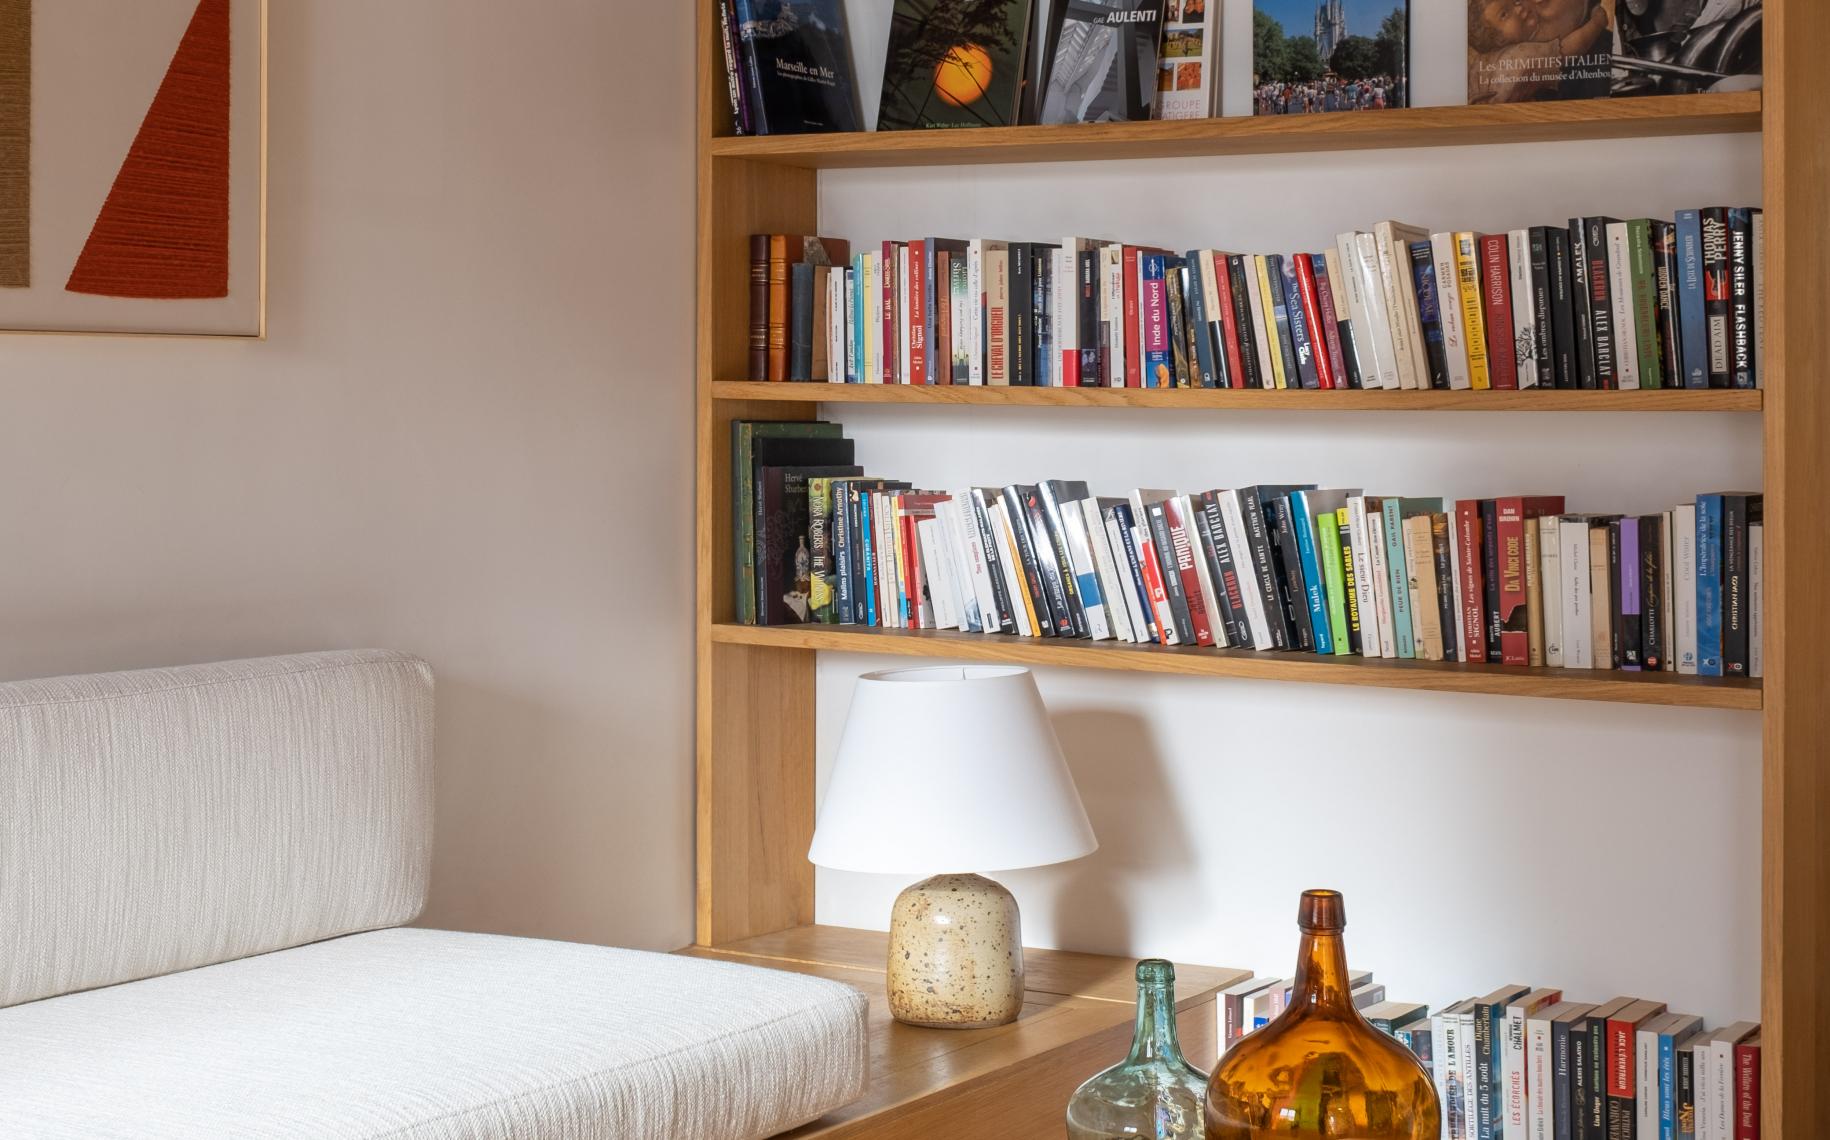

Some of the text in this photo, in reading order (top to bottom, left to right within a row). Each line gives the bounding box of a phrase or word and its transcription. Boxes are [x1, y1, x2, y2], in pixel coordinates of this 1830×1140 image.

[1093, 10, 1158, 24] GAE AULENTI
[776, 57, 808, 74] Marseille
[809, 67, 818, 76] en
[819, 66, 835, 79] Mer
[1479, 56, 1562, 72] Les PRIMITIFS
[1479, 71, 1568, 84] La collection du musée
[1702, 217, 1716, 266] THOMAS
[1715, 220, 1727, 260] PERRY
[1439, 261, 1447, 289] CARMEN
[1444, 261, 1453, 288] POSADAS
[1487, 240, 1504, 305] COLIN HARRISON
[1574, 242, 1584, 284] AMALEK
[1289, 292, 1301, 311] Sea
[1732, 230, 1747, 369] JENNY SILER FLASHBACK
[990, 307, 1004, 343] D'ORGUEIL
[1150, 282, 1161, 346] Inde du Nord
[1292, 310, 1304, 342] Sisters
[1537, 287, 1549, 360] Les ombres disparues
[915, 325, 924, 349] Signol
[1595, 310, 1611, 376] ALEX BARCLAY
[1713, 318, 1723, 369] DEAD AIM
[991, 345, 1004, 371] CHEVAL
[812, 496, 825, 516] NORA
[1247, 496, 1257, 511] PEARL
[1250, 511, 1262, 538] MATTHEW
[1277, 504, 1289, 534] John Wray
[1699, 515, 1707, 523] la
[1699, 523, 1707, 532] de
[811, 519, 825, 549] ROBERTS
[835, 487, 848, 601] Malins plaisirs Christine Arnothy
[1205, 502, 1230, 564] ALEX BARCLAY
[1463, 520, 1472, 566] Sainte-Colombe
[1170, 525, 1194, 570] PANIQUE
[1257, 545, 1267, 564] DANTE
[1343, 545, 1353, 571] SABLES
[1358, 552, 1365, 563] Le
[1699, 533, 1708, 576] L'Impératrice
[813, 556, 825, 568] THE
[1360, 564, 1368, 582] sieur
[1504, 536, 1521, 592] DA VINCI CODE
[1222, 570, 1243, 610] BLACKRUN
[1263, 573, 1273, 593] CERCLE
[1394, 569, 1402, 584] RIEN
[1467, 574, 1475, 591] vignes
[1309, 584, 1322, 613] Malek
[1348, 587, 1359, 621] ROYAUME
[1361, 584, 1370, 603] Dieu
[1731, 576, 1739, 630] CHRISTIAN JACQ
[1352, 622, 1360, 632] LE
[1471, 606, 1480, 638] SIGNOL
[1492, 611, 1501, 637] AUBERT
[1474, 1019, 1483, 1041] Diane
[1481, 1006, 1491, 1055] Chamberlain
[1513, 1016, 1523, 1051] CHALMET
[1464, 1044, 1473, 1080] ANTILLES
[1558, 1034, 1567, 1076] Harmonie
[1618, 1030, 1627, 1090] JACK L'ÉVENTREUR
[1662, 1057, 1670, 1071] étés
[1447, 1070, 1456, 1081] DE
[1478, 1062, 1488, 1083] août
[1662, 1072, 1670, 1082] les
[1479, 1093, 1489, 1105] du
[1510, 1071, 1521, 1126] LES ÉCORCHÉS
[1743, 1054, 1752, 1128] The Welfare of the Dead
[1480, 1107, 1490, 1125] nuit
[1593, 1096, 1601, 1114] Unger
[1663, 1101, 1671, 1121] Bleus
[1480, 1127, 1490, 1138] La
